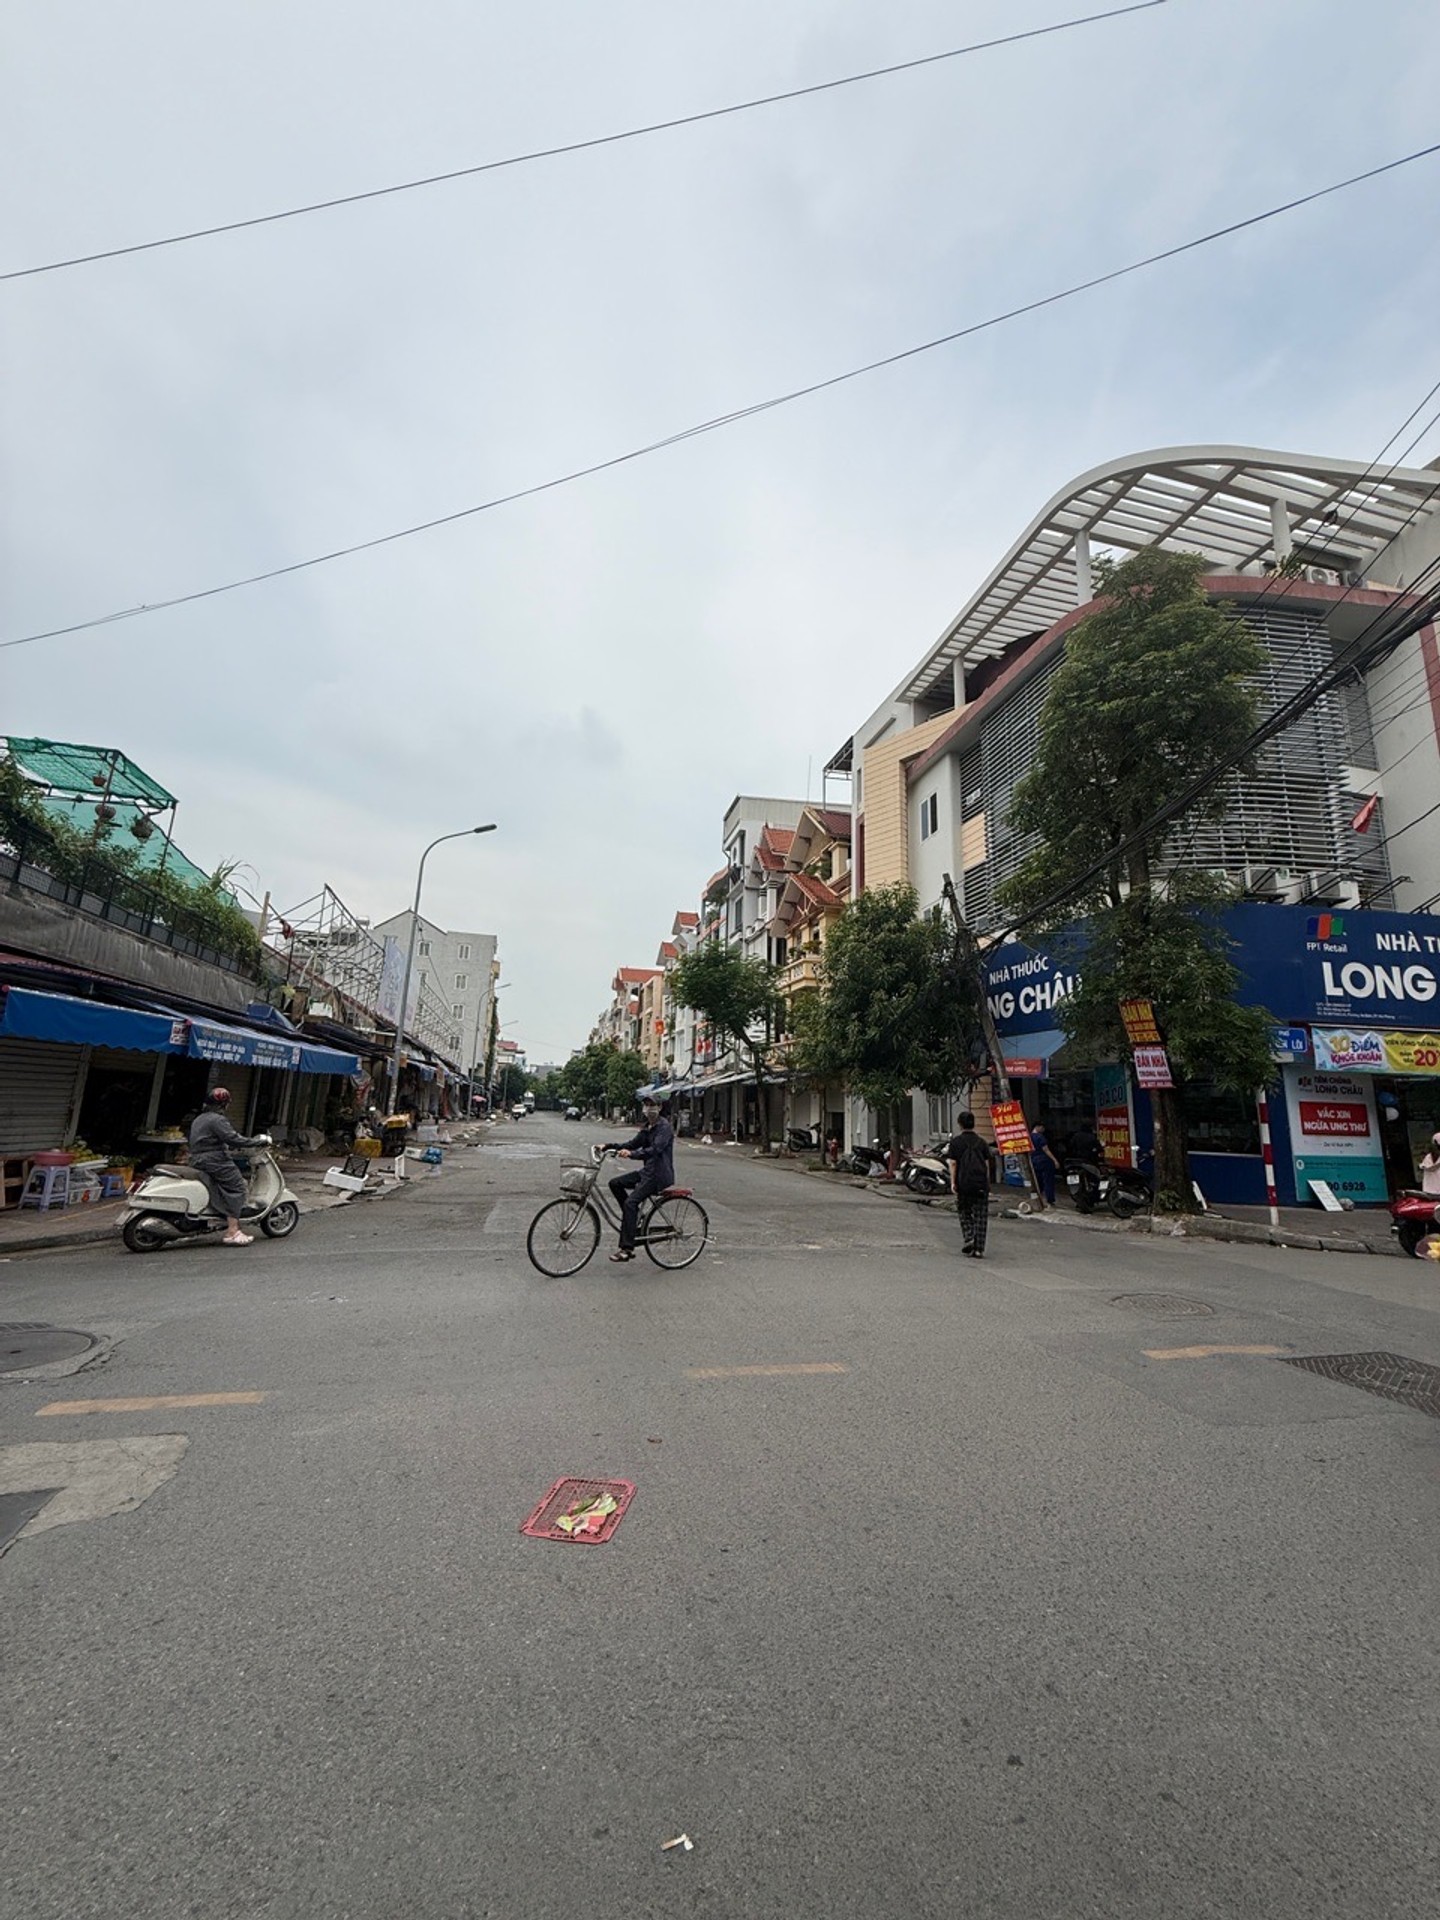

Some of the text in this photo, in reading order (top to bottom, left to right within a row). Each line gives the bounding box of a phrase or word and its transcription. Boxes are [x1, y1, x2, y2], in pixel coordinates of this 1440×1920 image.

[1322, 943, 1348, 953] Retail
[1375, 931, 1440, 954] NHÀ T
[989, 952, 1049, 985] NHÀ THUỐC
[1321, 961, 1438, 1002] LONG
[1413, 1048, 1440, 1068] 20
[1330, 1122, 1349, 1131] UNG
[1349, 1122, 1367, 1132] THƯ
[1341, 1181, 1366, 1191] 6928
